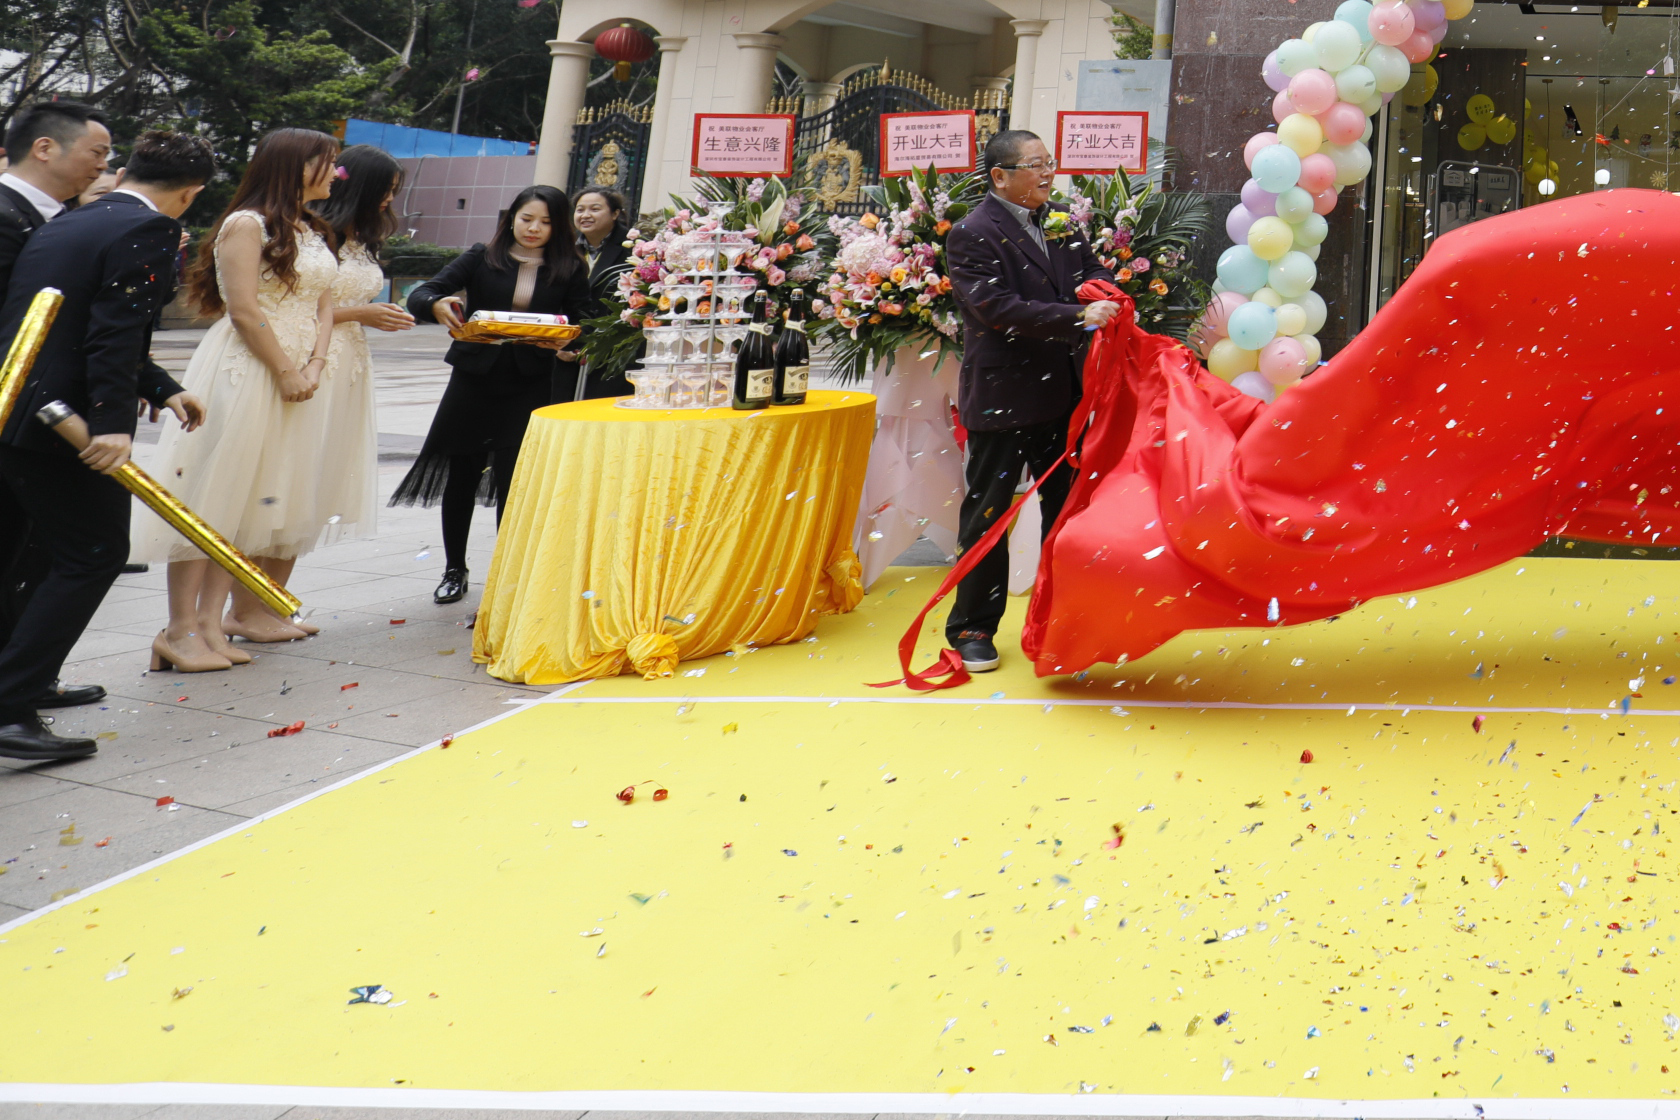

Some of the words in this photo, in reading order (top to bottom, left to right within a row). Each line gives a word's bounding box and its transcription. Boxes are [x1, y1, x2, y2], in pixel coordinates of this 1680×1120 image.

[904, 123, 948, 131] 美联物业会客厅
[704, 136, 781, 152] 生意兴隆
[893, 133, 964, 151] 开业大吉
[1067, 134, 1137, 149] 开业大吉
